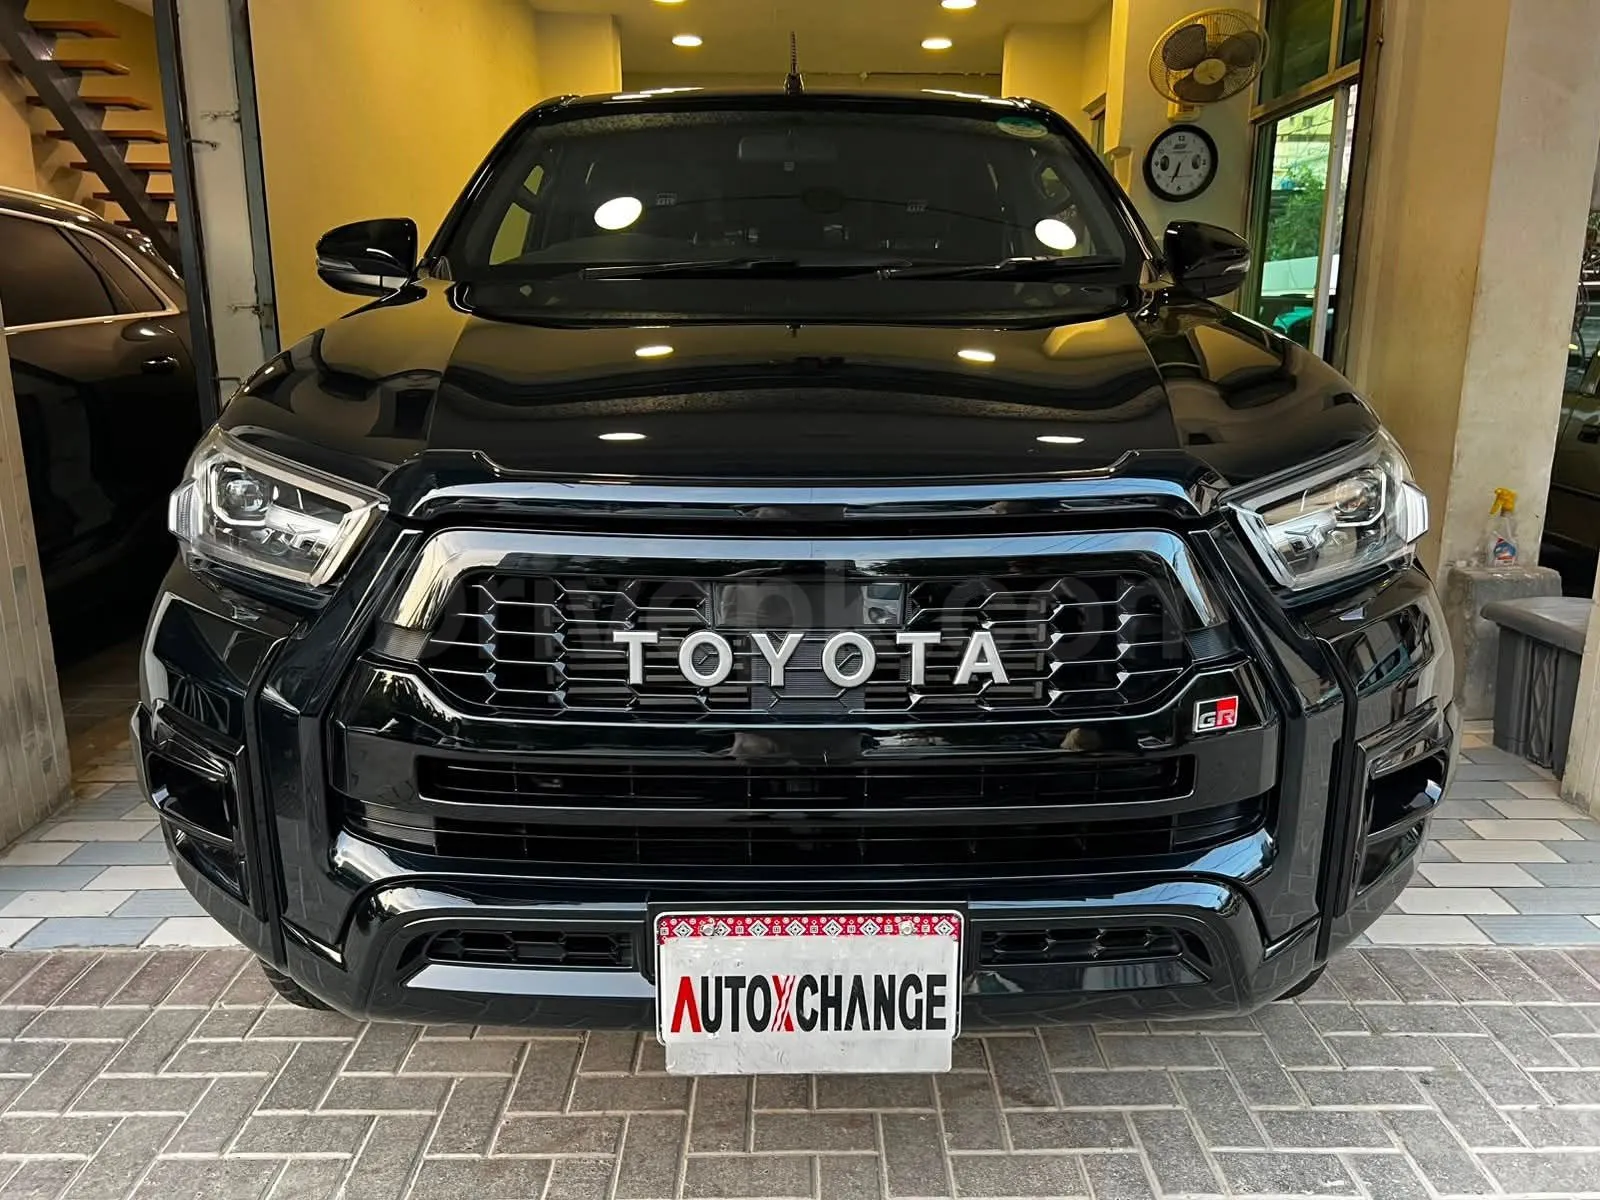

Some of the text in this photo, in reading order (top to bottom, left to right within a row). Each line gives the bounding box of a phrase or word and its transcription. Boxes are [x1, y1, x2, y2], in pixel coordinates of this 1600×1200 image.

[612, 629, 1010, 687] TOYOTA
[1198, 709, 1235, 729] GR
[670, 973, 948, 1033] AUTOXCHANGE
